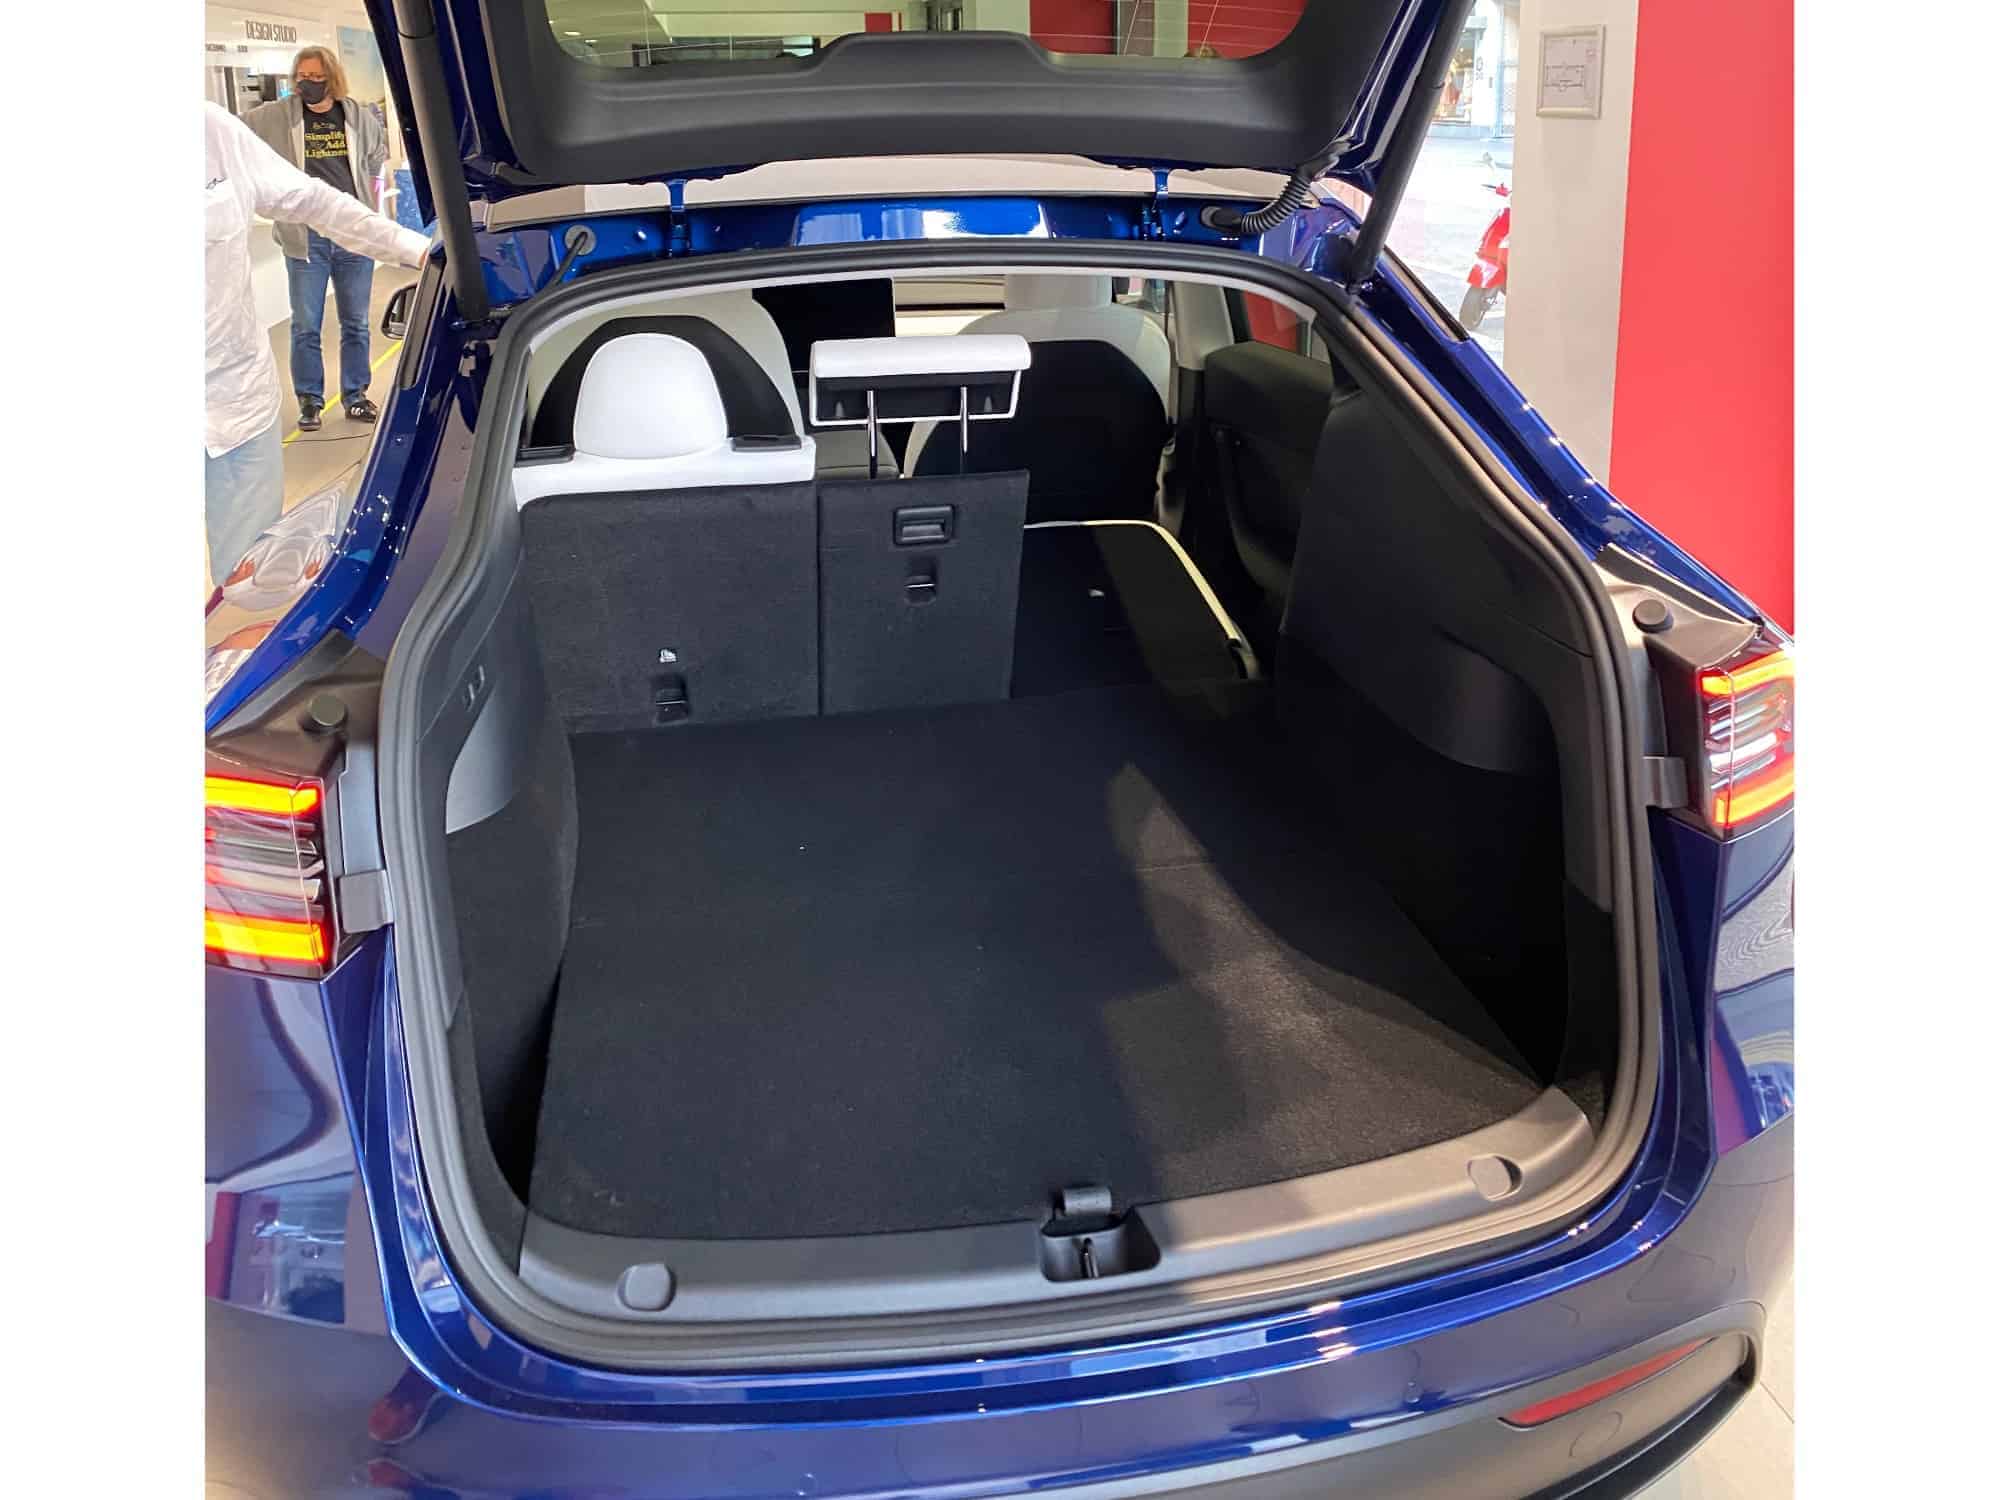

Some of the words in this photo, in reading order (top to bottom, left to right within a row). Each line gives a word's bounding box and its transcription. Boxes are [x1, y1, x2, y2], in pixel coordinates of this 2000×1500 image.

[246, 20, 272, 40] DESIGN
[273, 24, 296, 43] STUDIO
[304, 131, 345, 142] Simplify
[325, 140, 345, 149] Add
[304, 150, 348, 159] Lightnes
